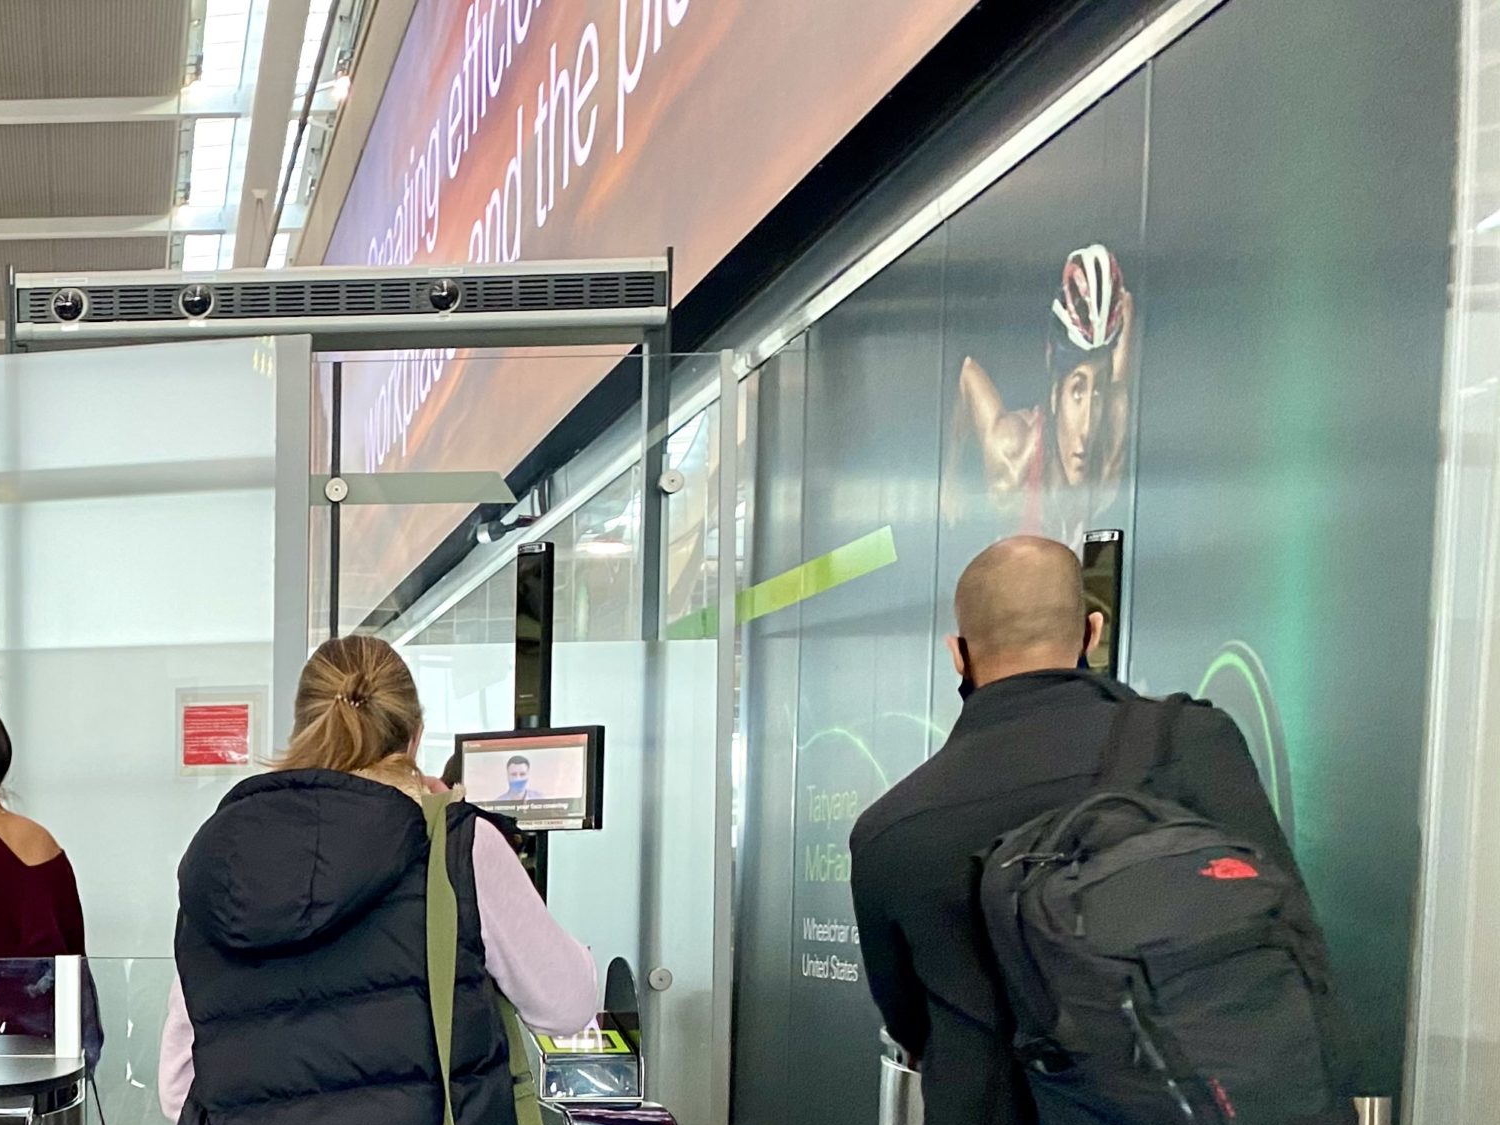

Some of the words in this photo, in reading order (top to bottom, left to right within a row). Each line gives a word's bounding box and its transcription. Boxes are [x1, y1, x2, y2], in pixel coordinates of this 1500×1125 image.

[534, 22, 599, 228] the
[803, 917, 850, 943] Wheelchair
[802, 953, 829, 979] United
[830, 954, 858, 982] States
